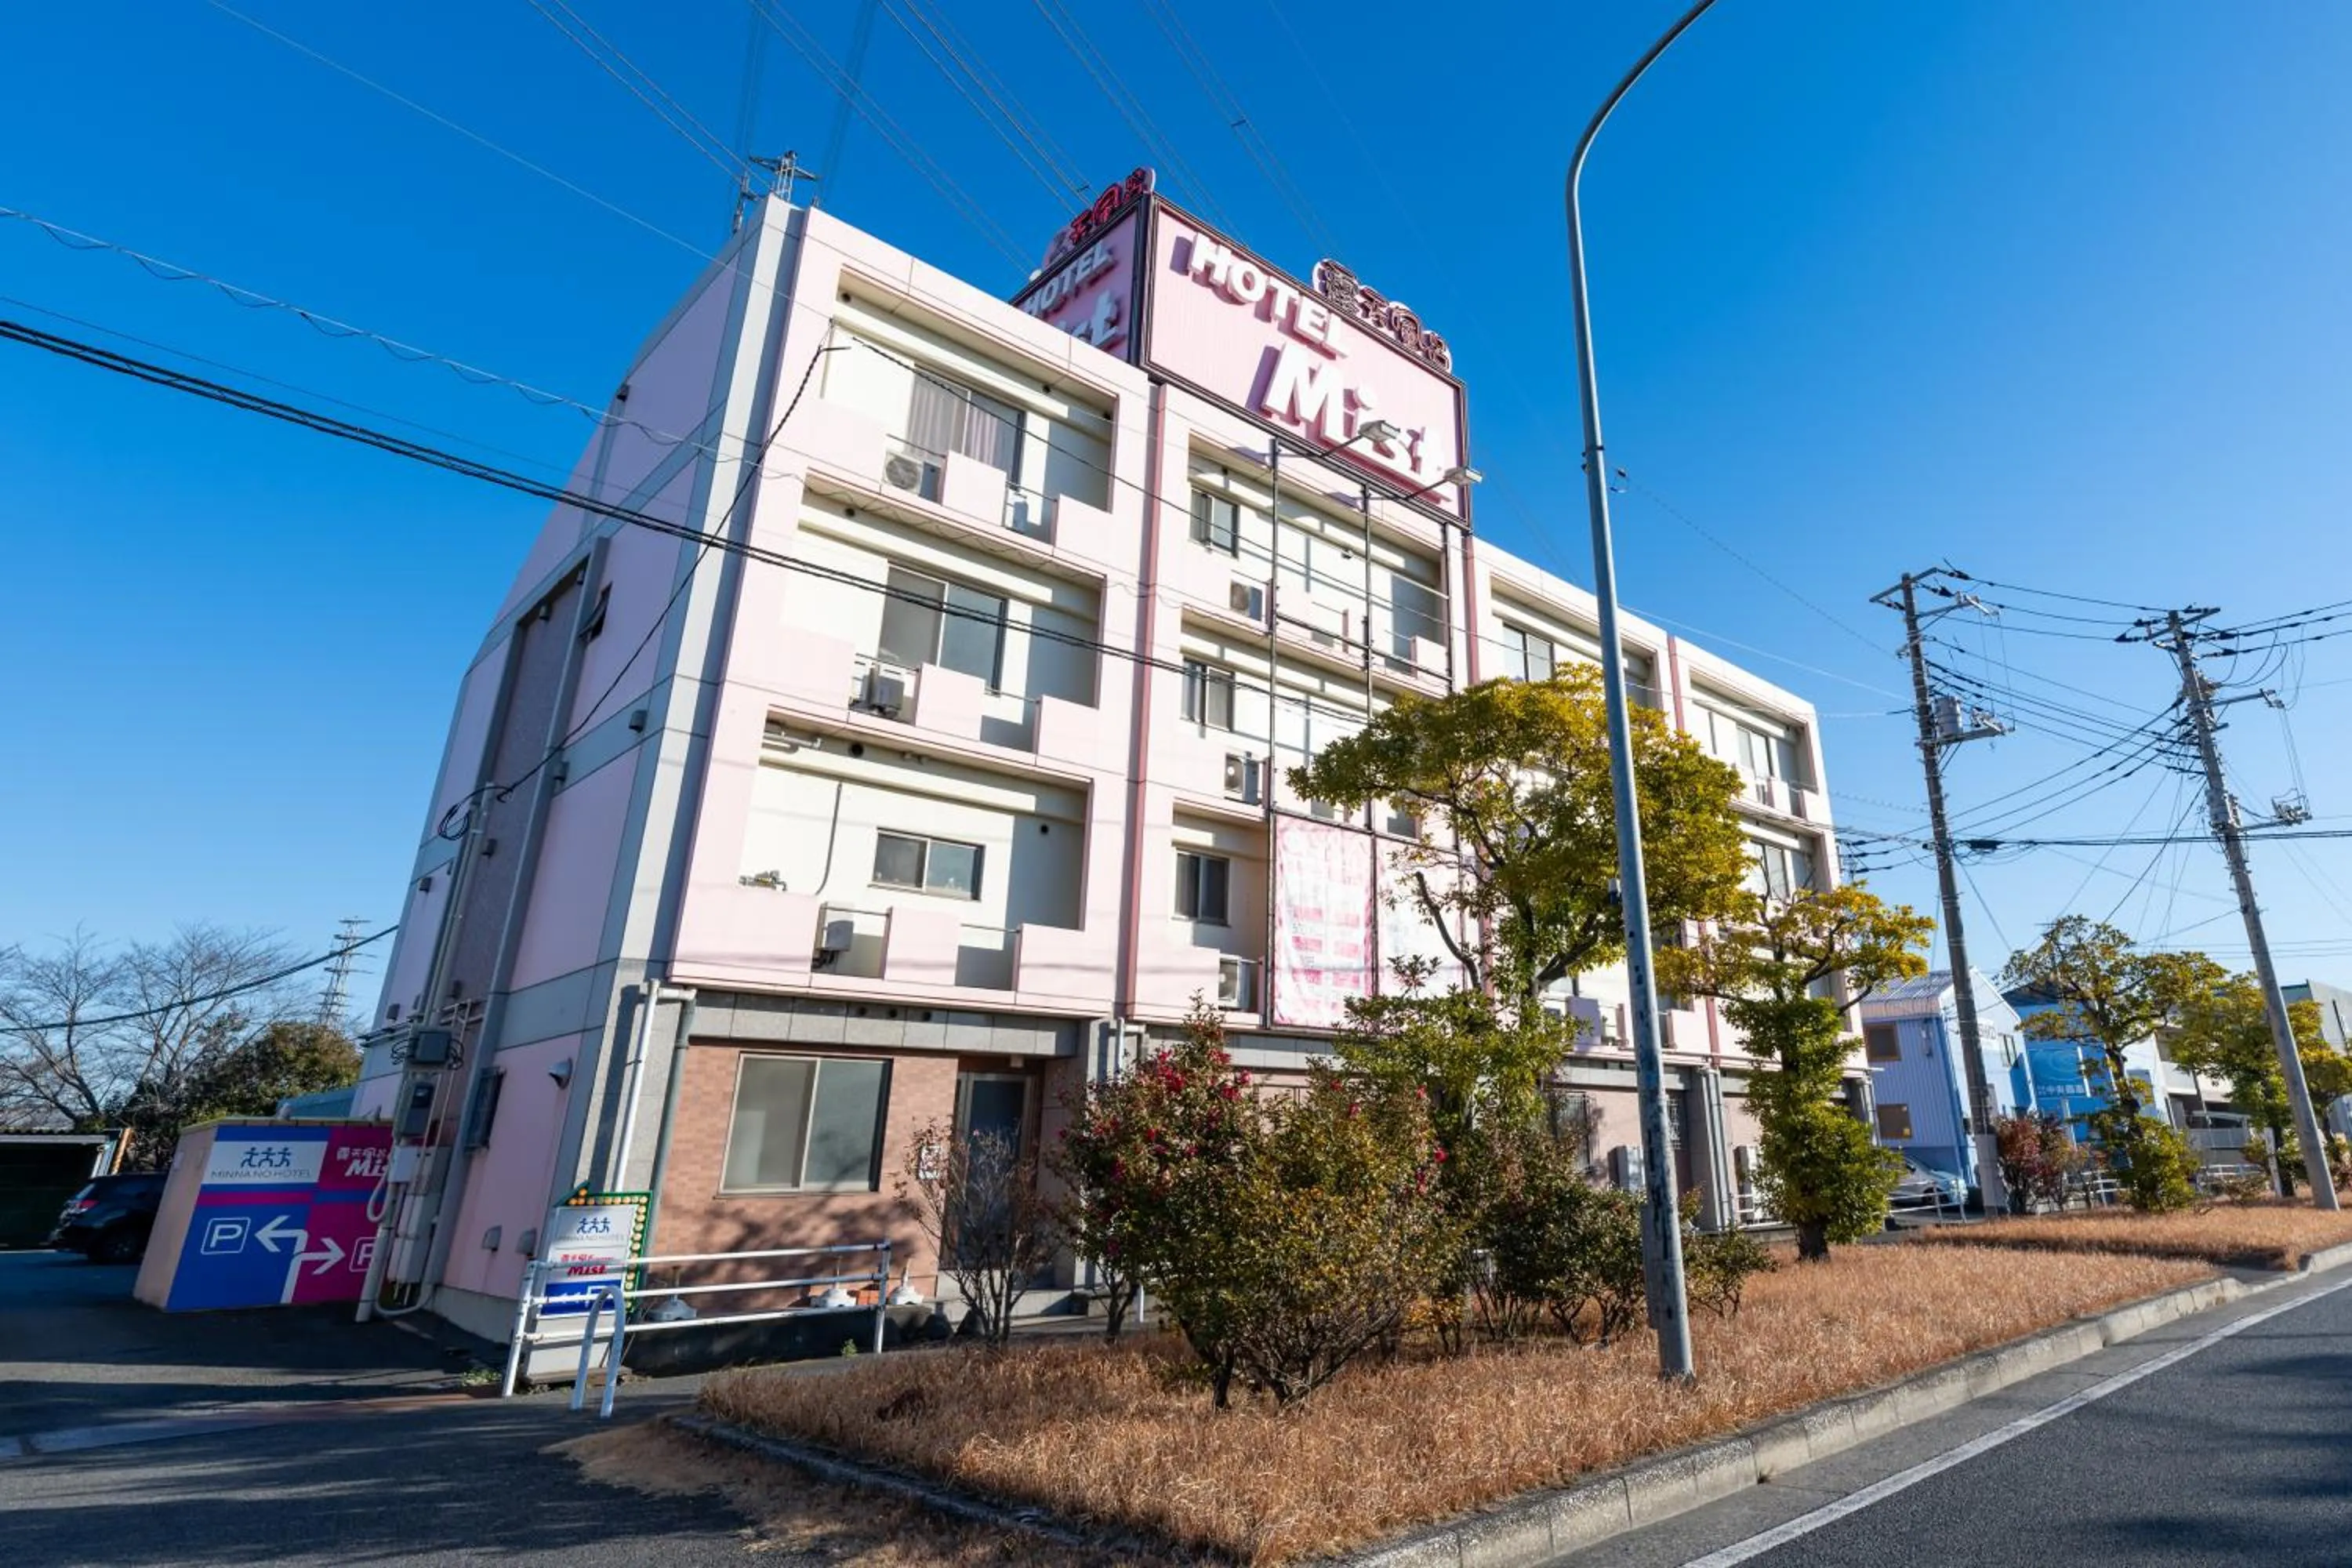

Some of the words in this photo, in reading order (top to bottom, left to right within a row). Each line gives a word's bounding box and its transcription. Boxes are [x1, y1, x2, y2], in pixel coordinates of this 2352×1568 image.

[1024, 239, 1112, 315] HOTEL
[1191, 232, 1348, 358] HOTEL
[1262, 342, 1445, 488] Mist
[211, 1171, 250, 1179] MINNA
[254, 1170, 270, 1178] NO
[274, 1169, 310, 1178] HOTEL
[209, 1225, 243, 1248] P
[567, 1264, 607, 1276] Mist
